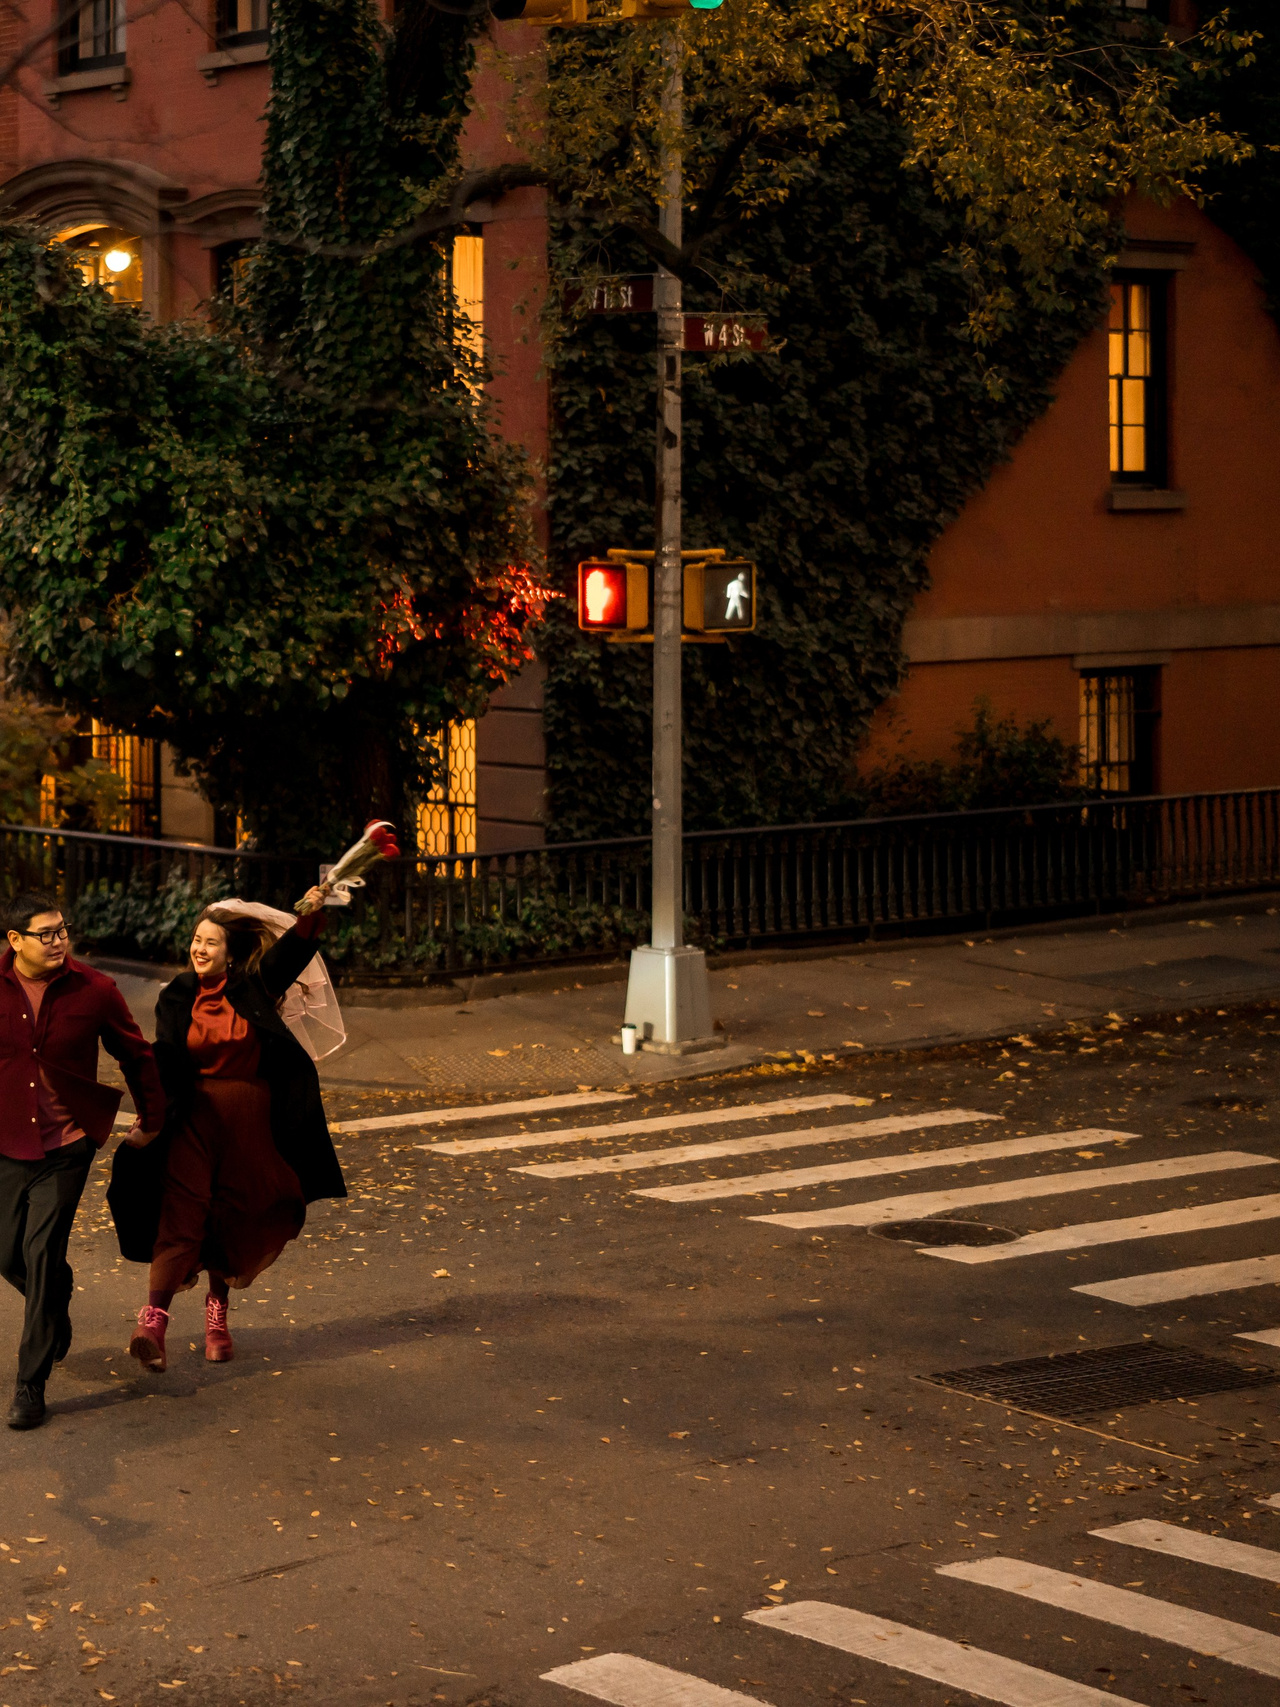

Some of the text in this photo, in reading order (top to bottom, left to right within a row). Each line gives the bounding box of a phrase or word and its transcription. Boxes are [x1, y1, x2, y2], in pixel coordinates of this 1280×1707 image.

[620, 285, 632, 308] St
[703, 323, 745, 346] W 4 St
